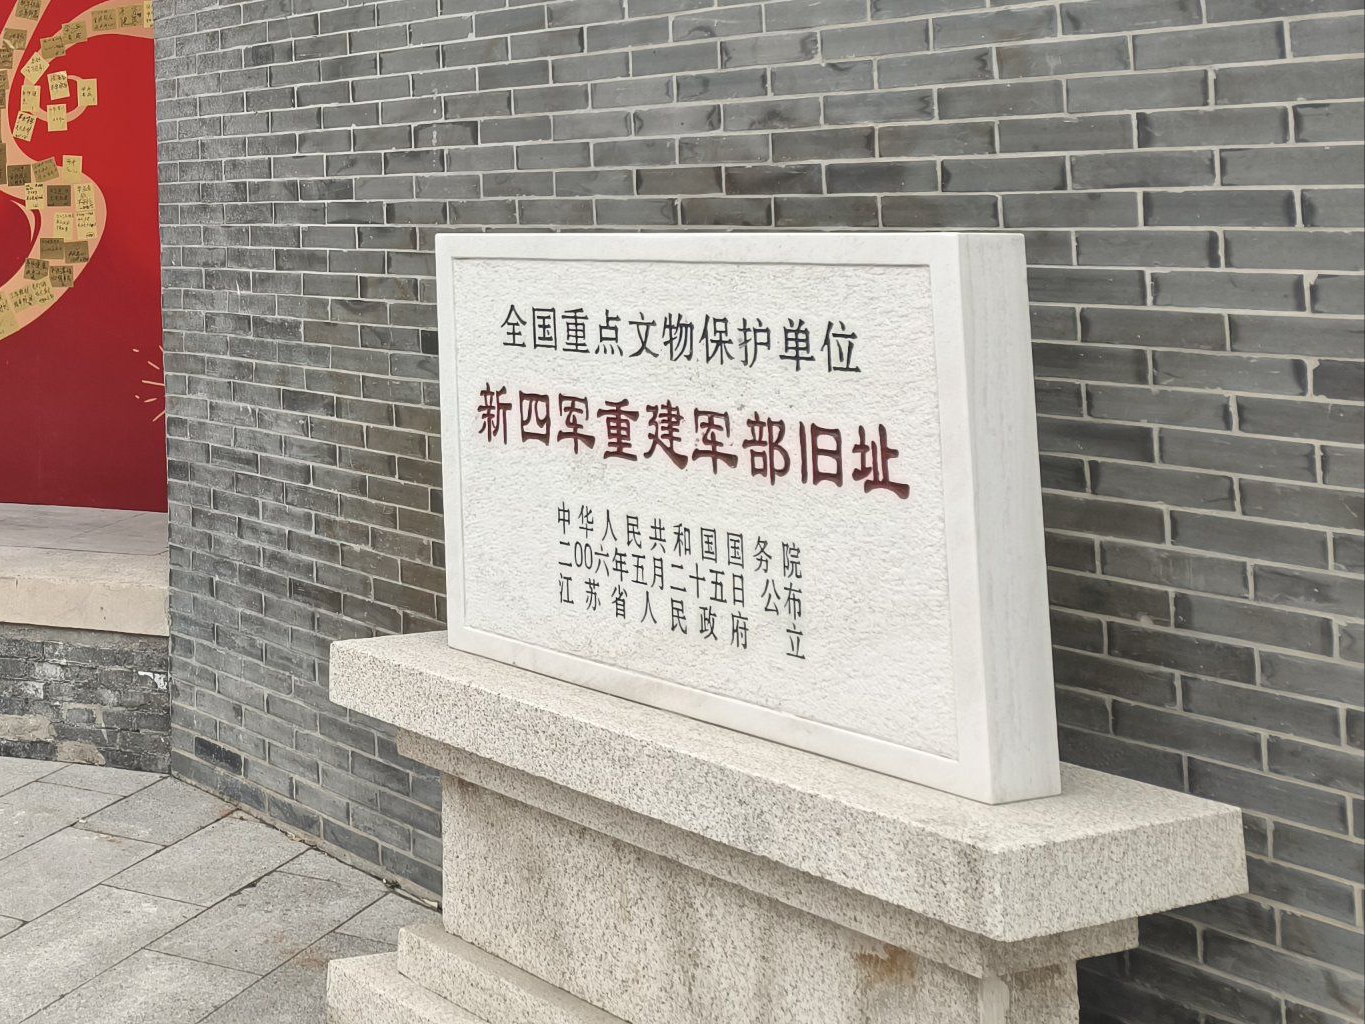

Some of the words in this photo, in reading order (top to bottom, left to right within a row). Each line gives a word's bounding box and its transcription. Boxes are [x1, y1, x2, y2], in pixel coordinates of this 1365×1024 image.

[500, 304, 862, 373] 全国重点文物保护单位
[477, 381, 911, 500] 新四军重建军部旧址
[557, 501, 802, 579] 中华人民共和国国务院
